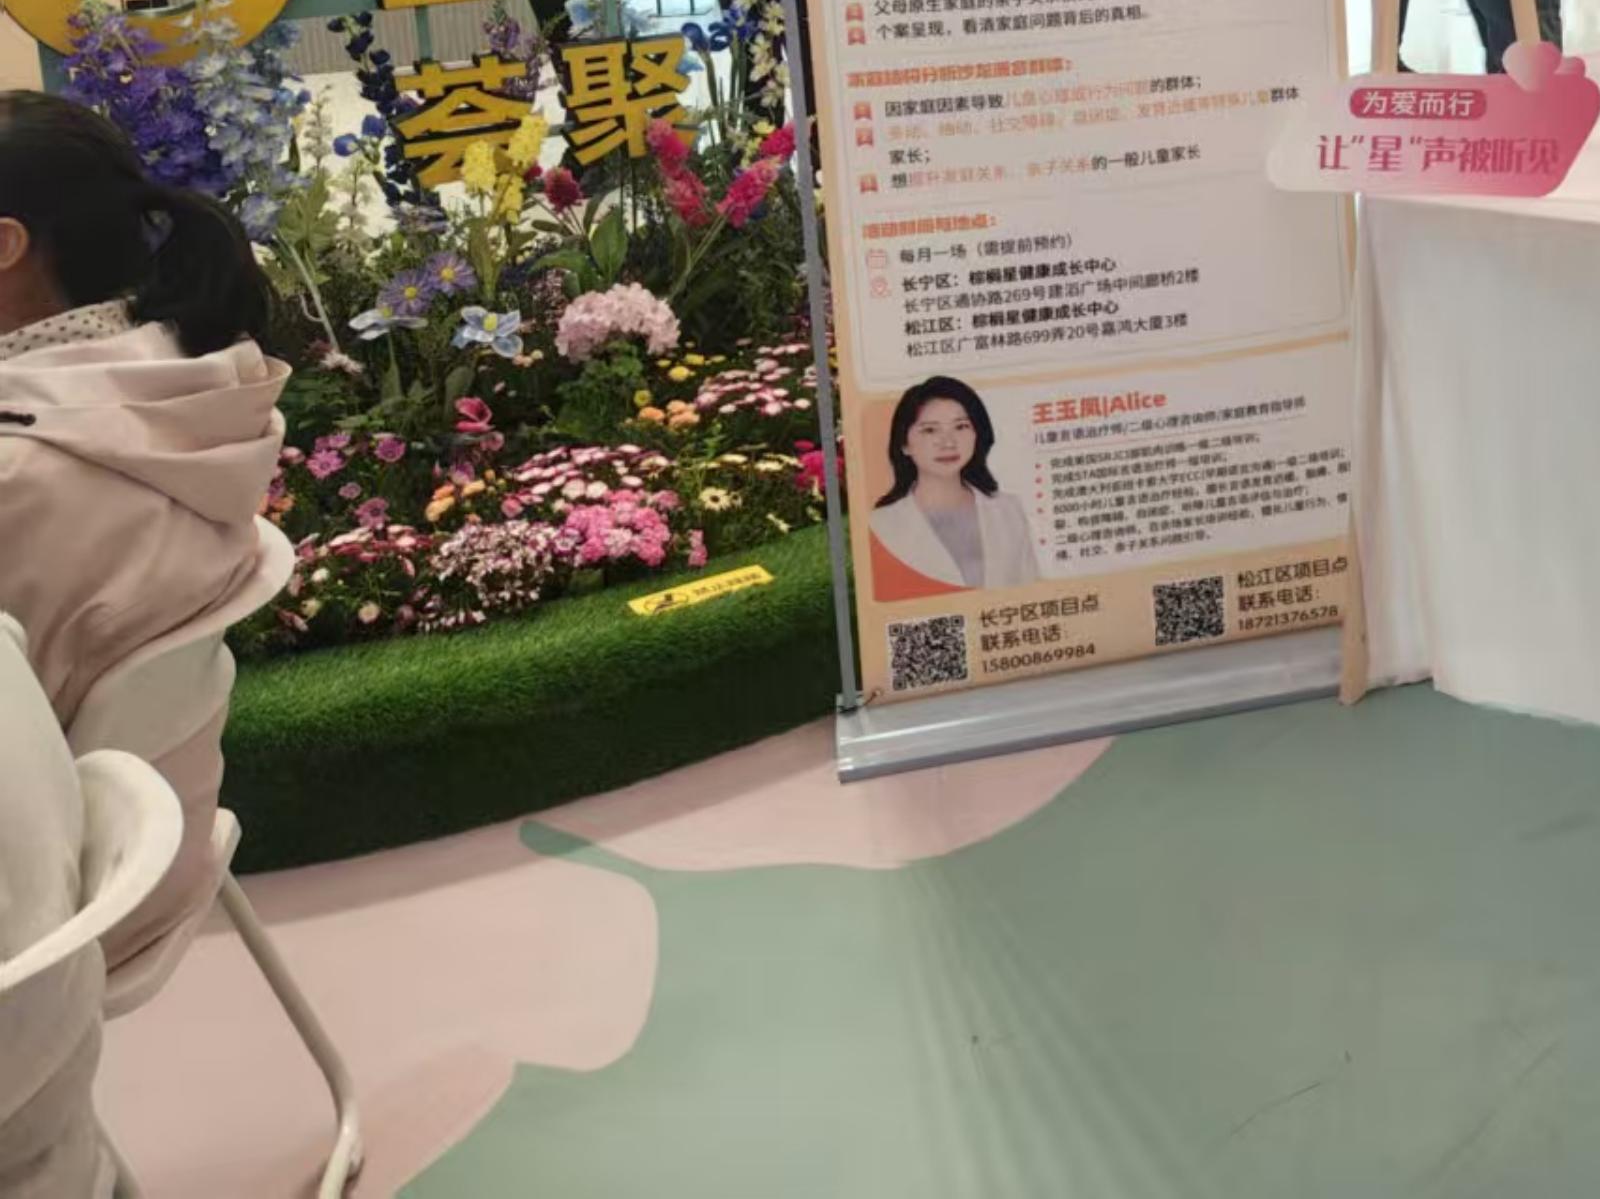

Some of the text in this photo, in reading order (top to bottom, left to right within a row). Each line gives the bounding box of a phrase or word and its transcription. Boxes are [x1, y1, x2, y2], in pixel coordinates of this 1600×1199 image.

[1362, 90, 1475, 117] 为爱而行
[1238, 556, 1348, 589] 松江区项目点
[980, 593, 1100, 629] 长宁区项目点
[1238, 604, 1338, 632] 18721376578
[982, 642, 1096, 674] 15800869984
